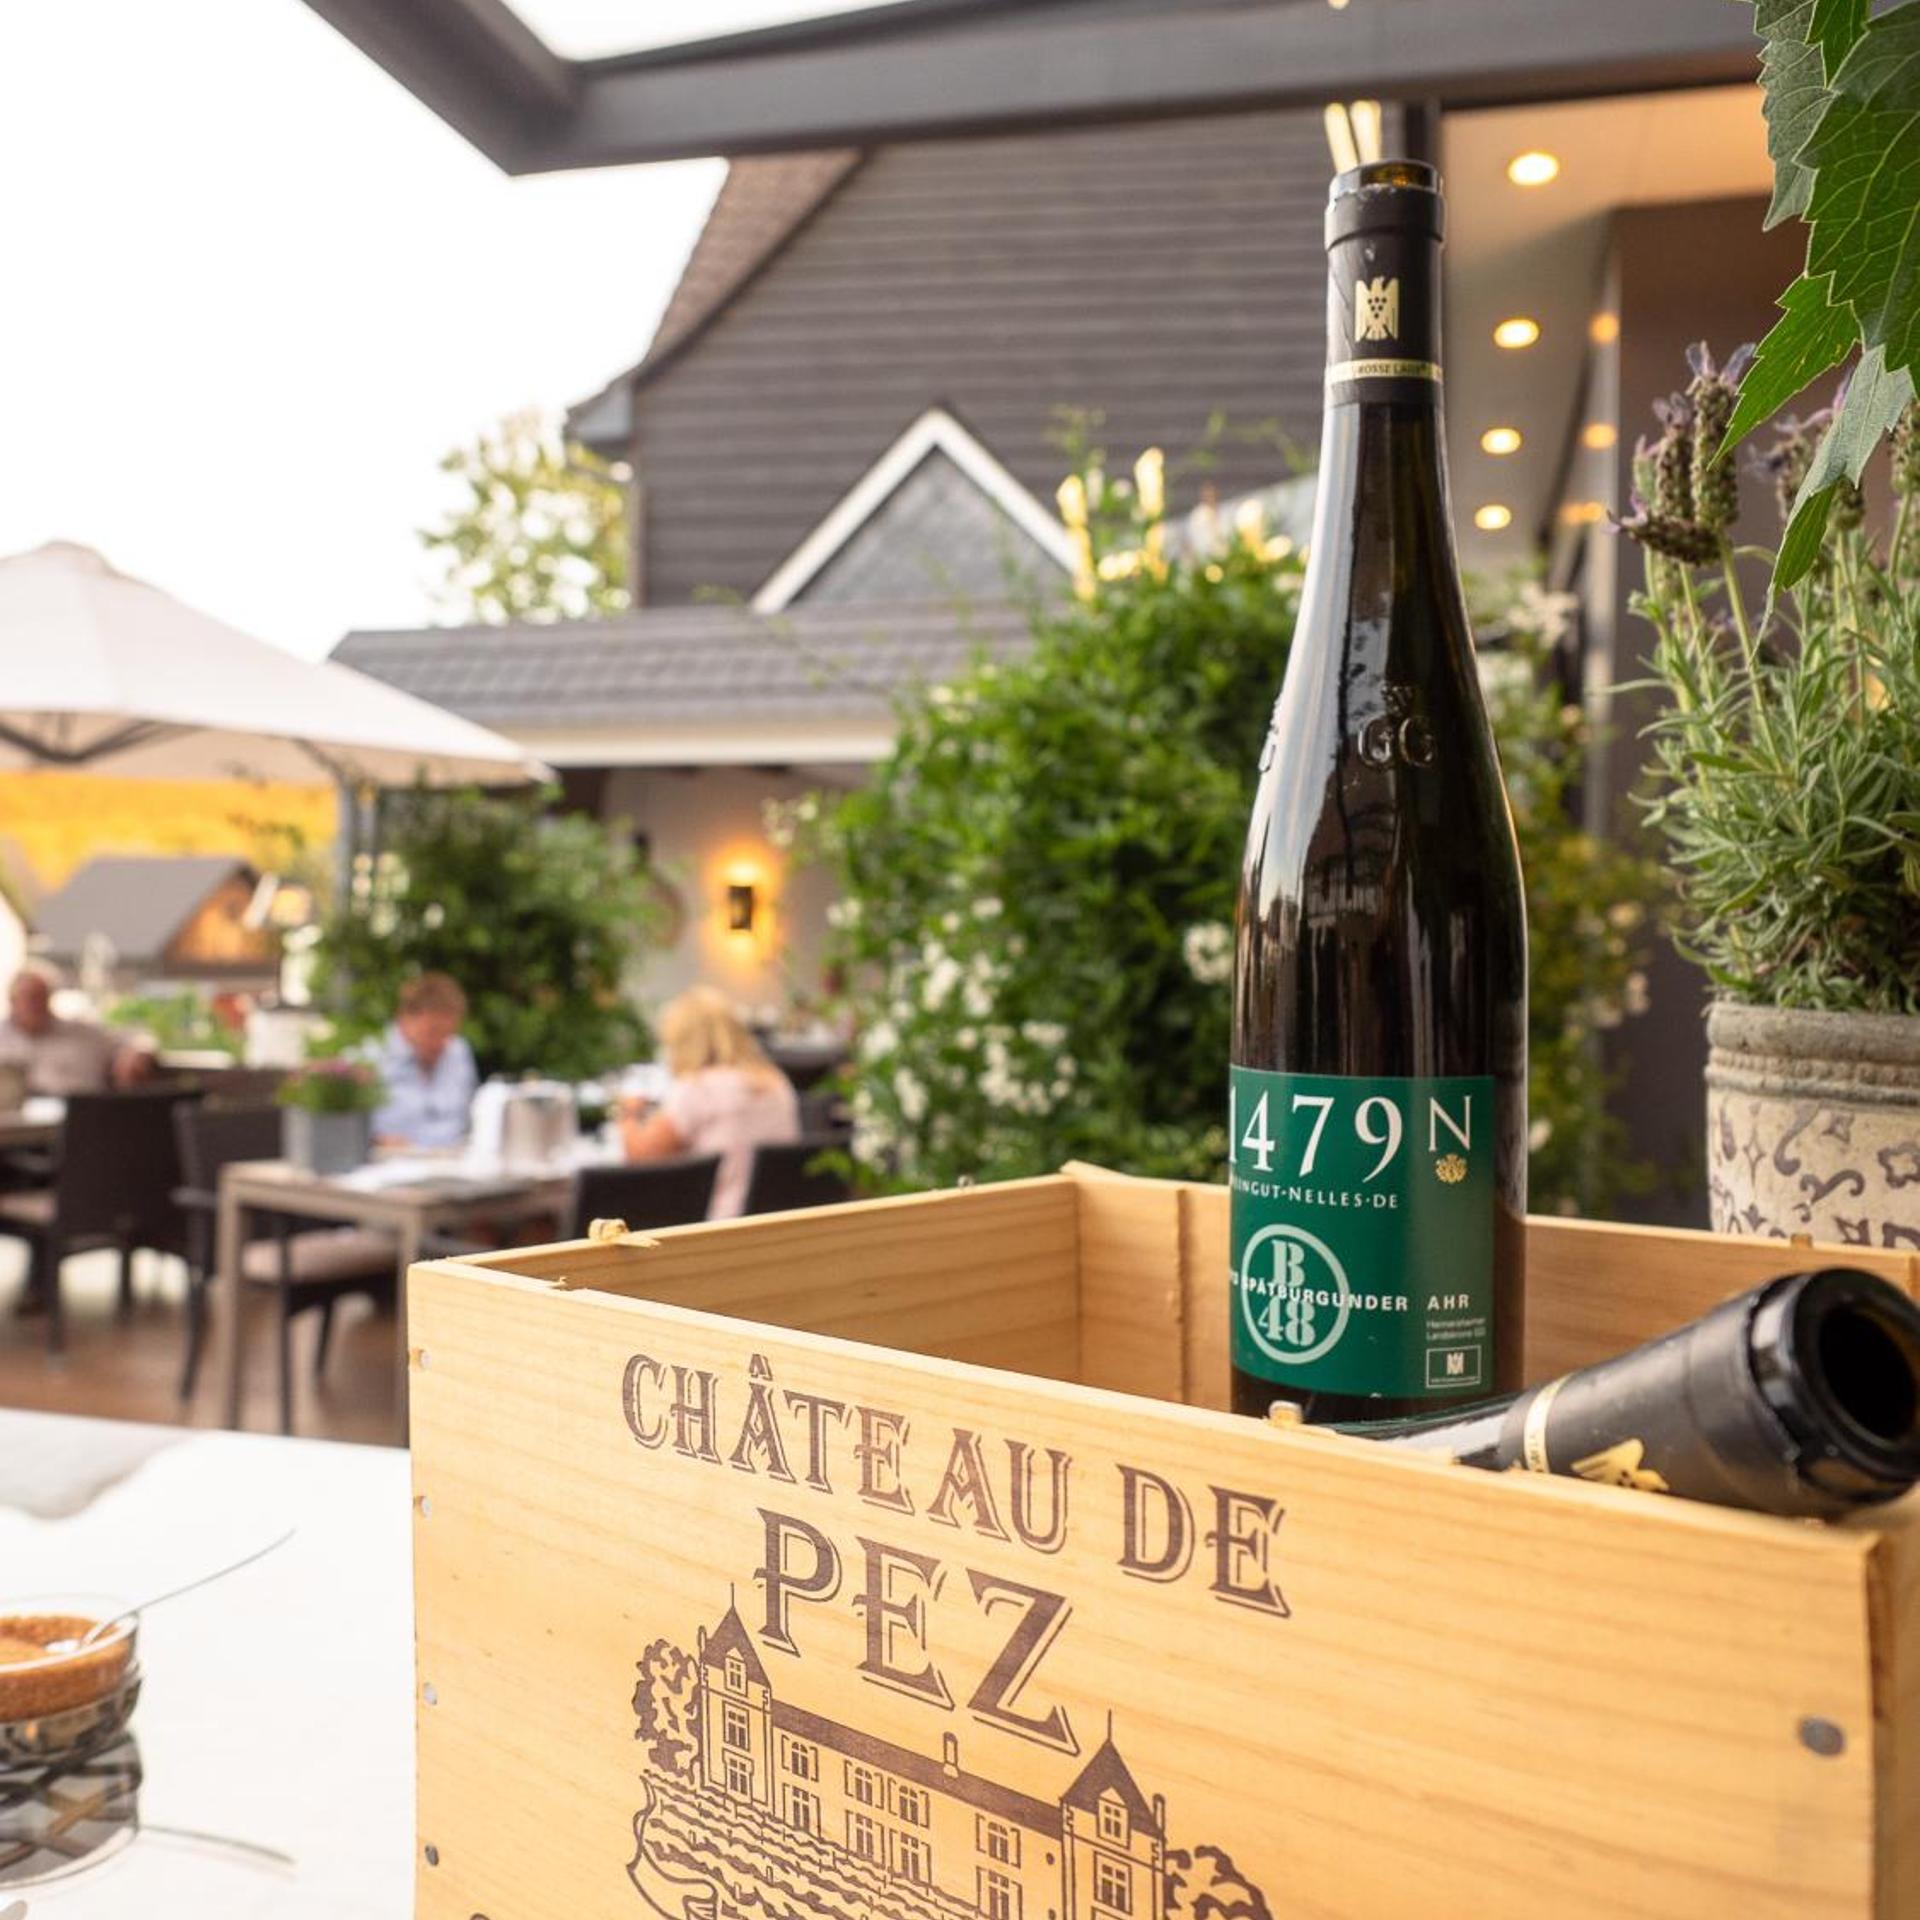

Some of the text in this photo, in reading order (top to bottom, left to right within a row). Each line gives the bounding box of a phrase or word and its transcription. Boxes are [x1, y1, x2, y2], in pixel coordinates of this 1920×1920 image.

[1428, 1095, 1471, 1152] N
[1271, 1239, 1305, 1289] B
[1258, 1297, 1315, 1346] 48
[1427, 1294, 1470, 1311] AHR
[621, 1353, 1291, 1619] CHÂTEAU DE
[752, 1507, 1082, 1757] PEZ
